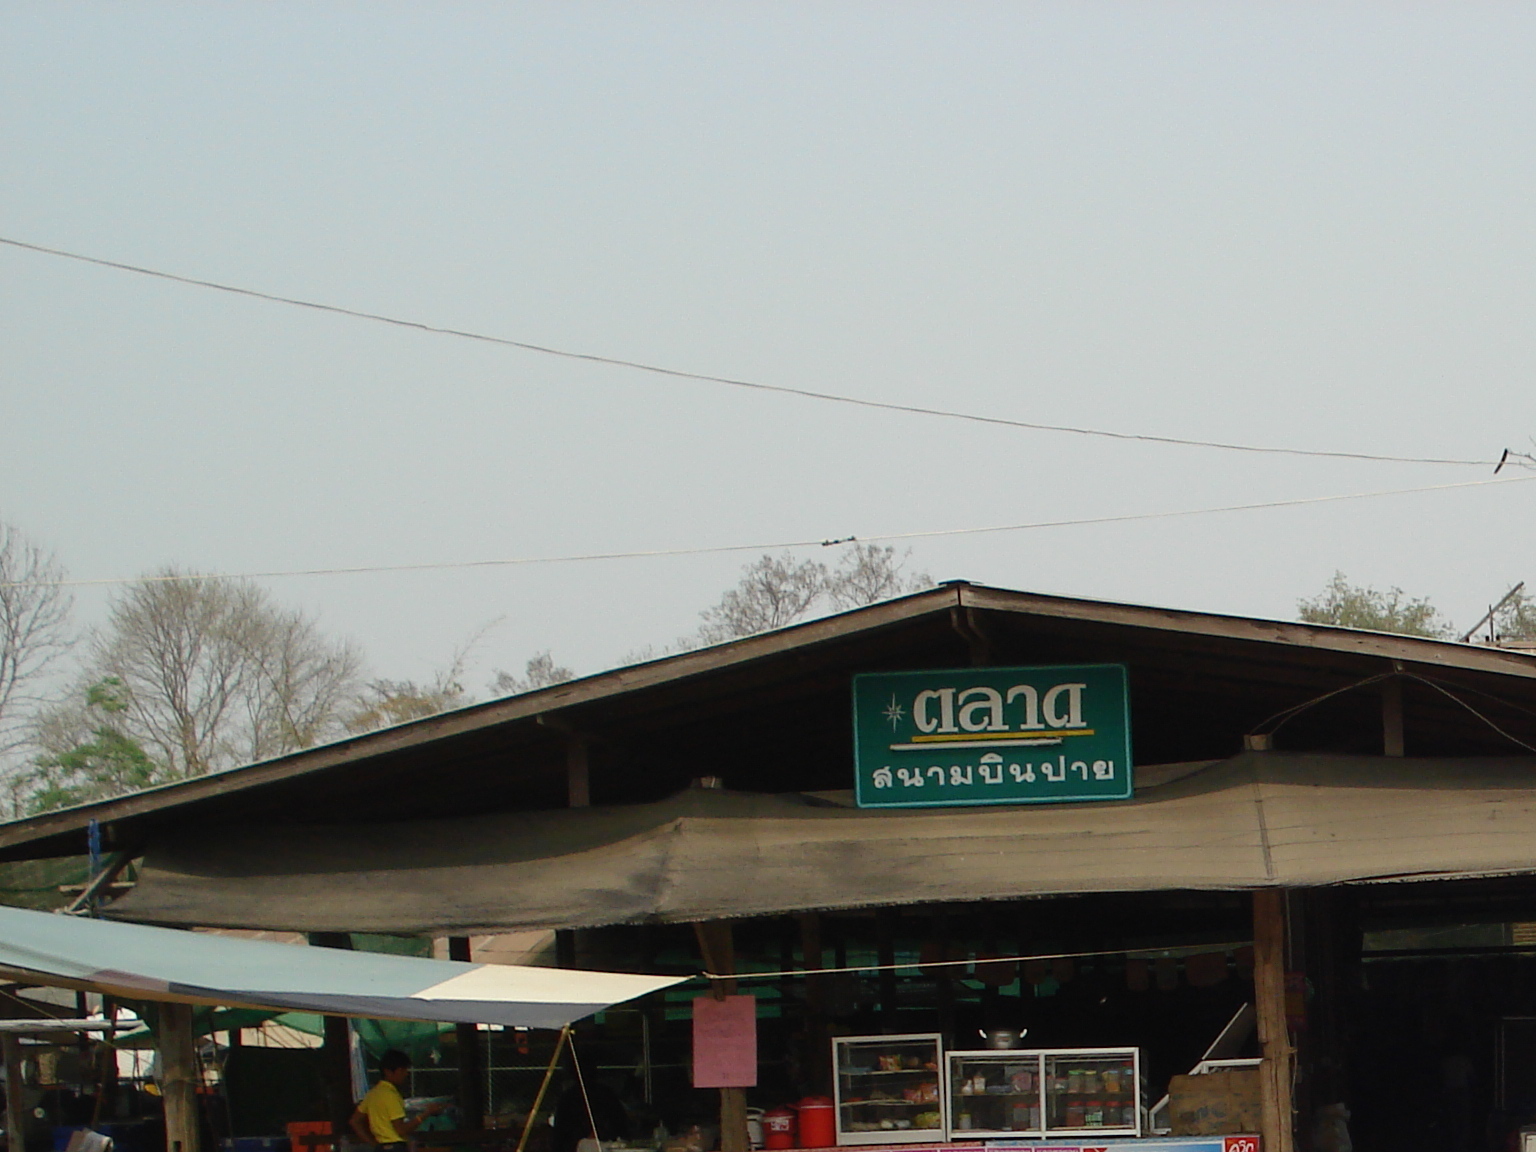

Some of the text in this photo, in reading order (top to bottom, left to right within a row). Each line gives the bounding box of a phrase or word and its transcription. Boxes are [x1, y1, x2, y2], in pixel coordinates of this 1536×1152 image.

[913, 682, 1087, 733] ตลาด
[872, 753, 1115, 790] สนามบินปาย
